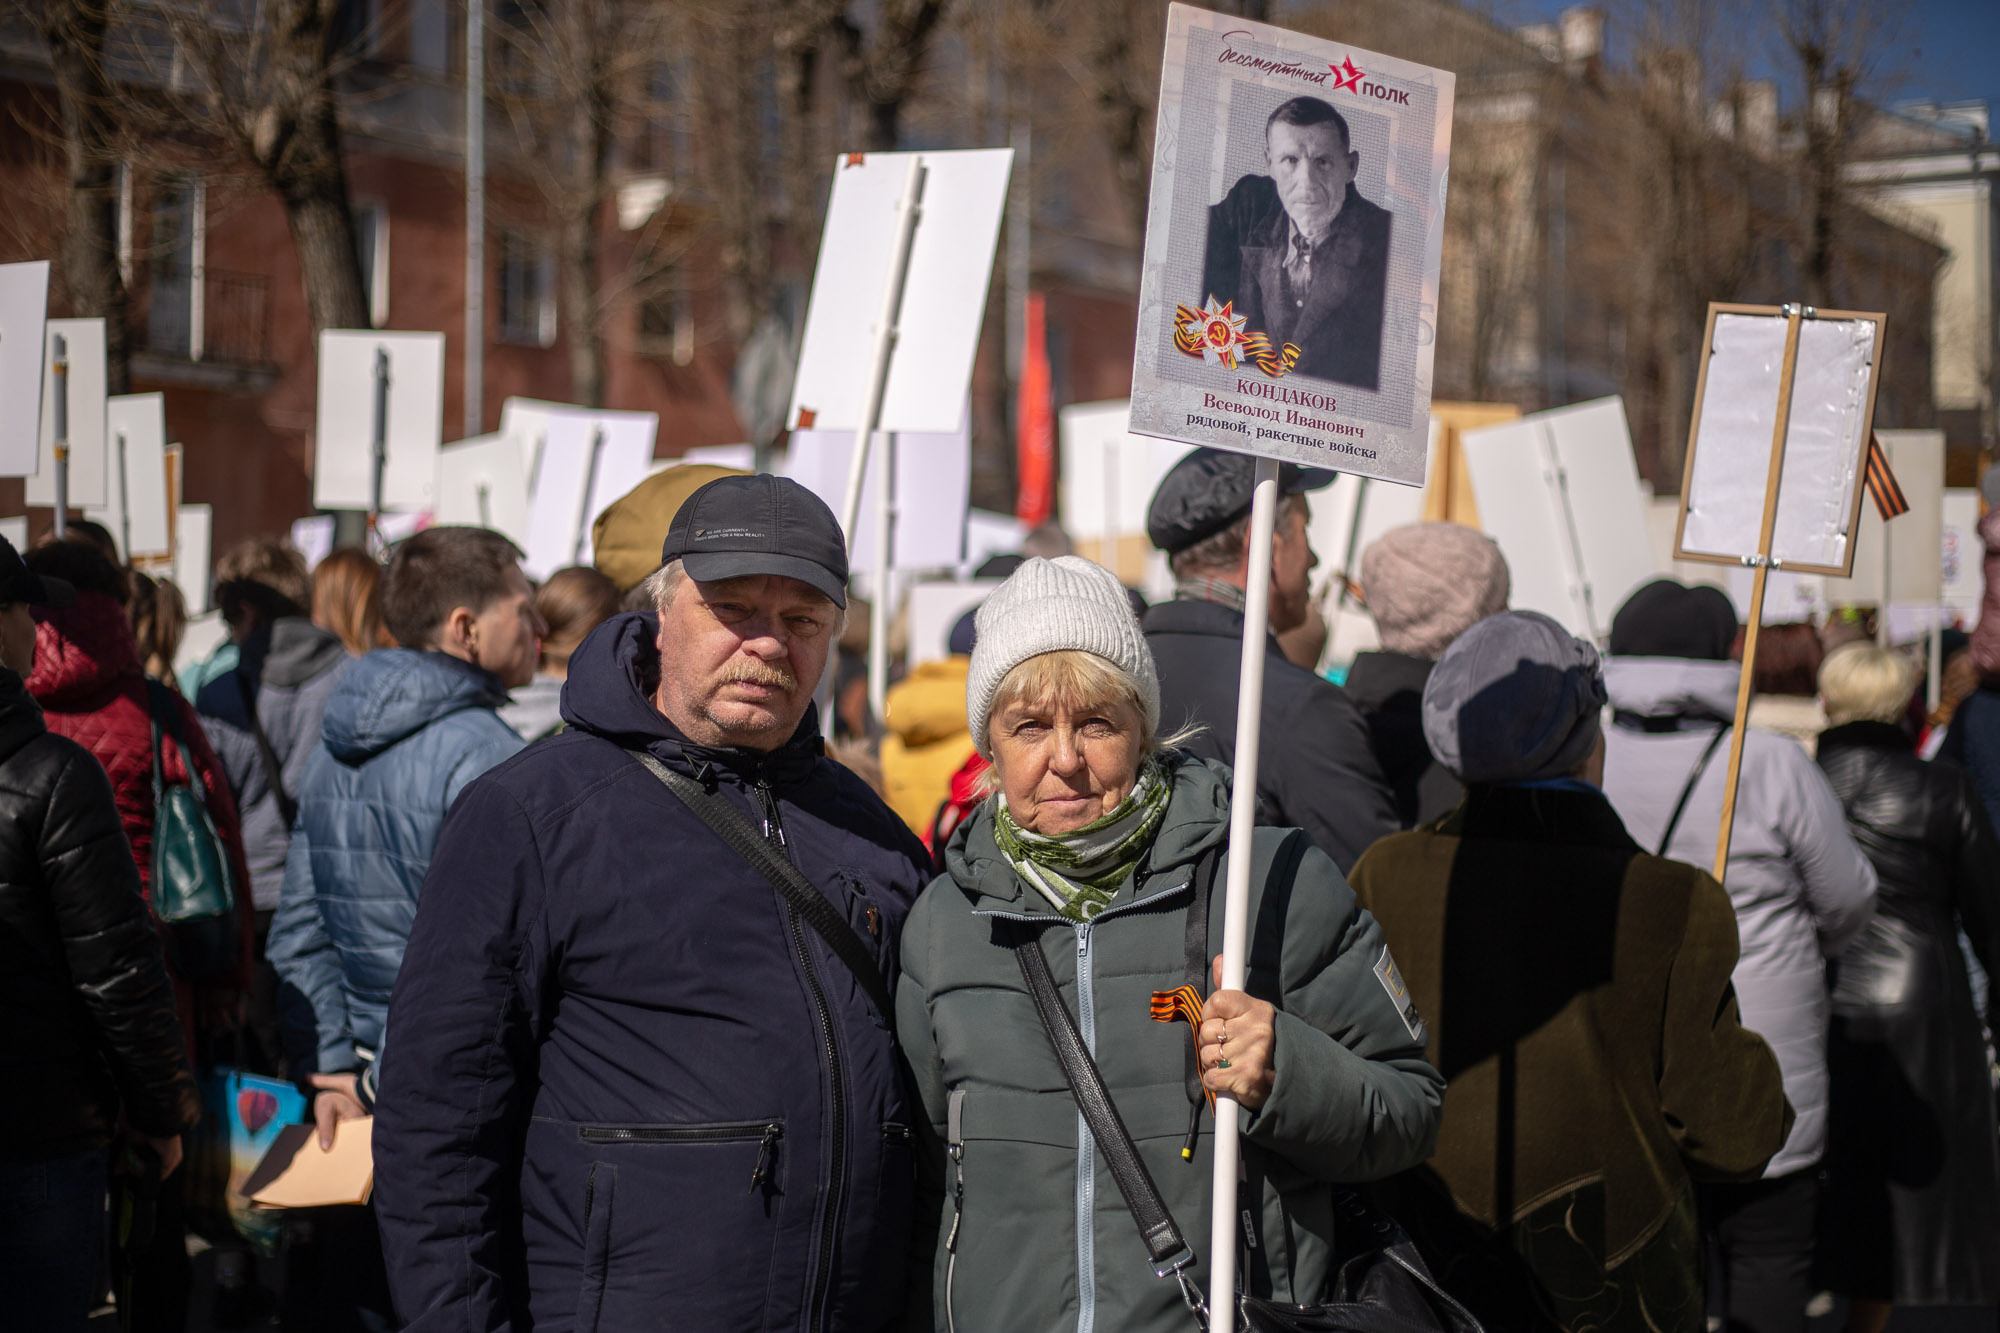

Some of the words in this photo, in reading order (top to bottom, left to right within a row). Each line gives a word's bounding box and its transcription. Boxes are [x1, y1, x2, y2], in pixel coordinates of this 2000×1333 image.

[1362, 81, 1410, 106] ПОЛК
[1203, 392, 1280, 423] Всеволод
[1285, 409, 1365, 438] Иванович
[1236, 378, 1337, 412] КОНДАКОВ
[1186, 413, 1251, 436] рядовой,
[1256, 426, 1325, 449] ракетные
[1329, 440, 1377, 460] войска
